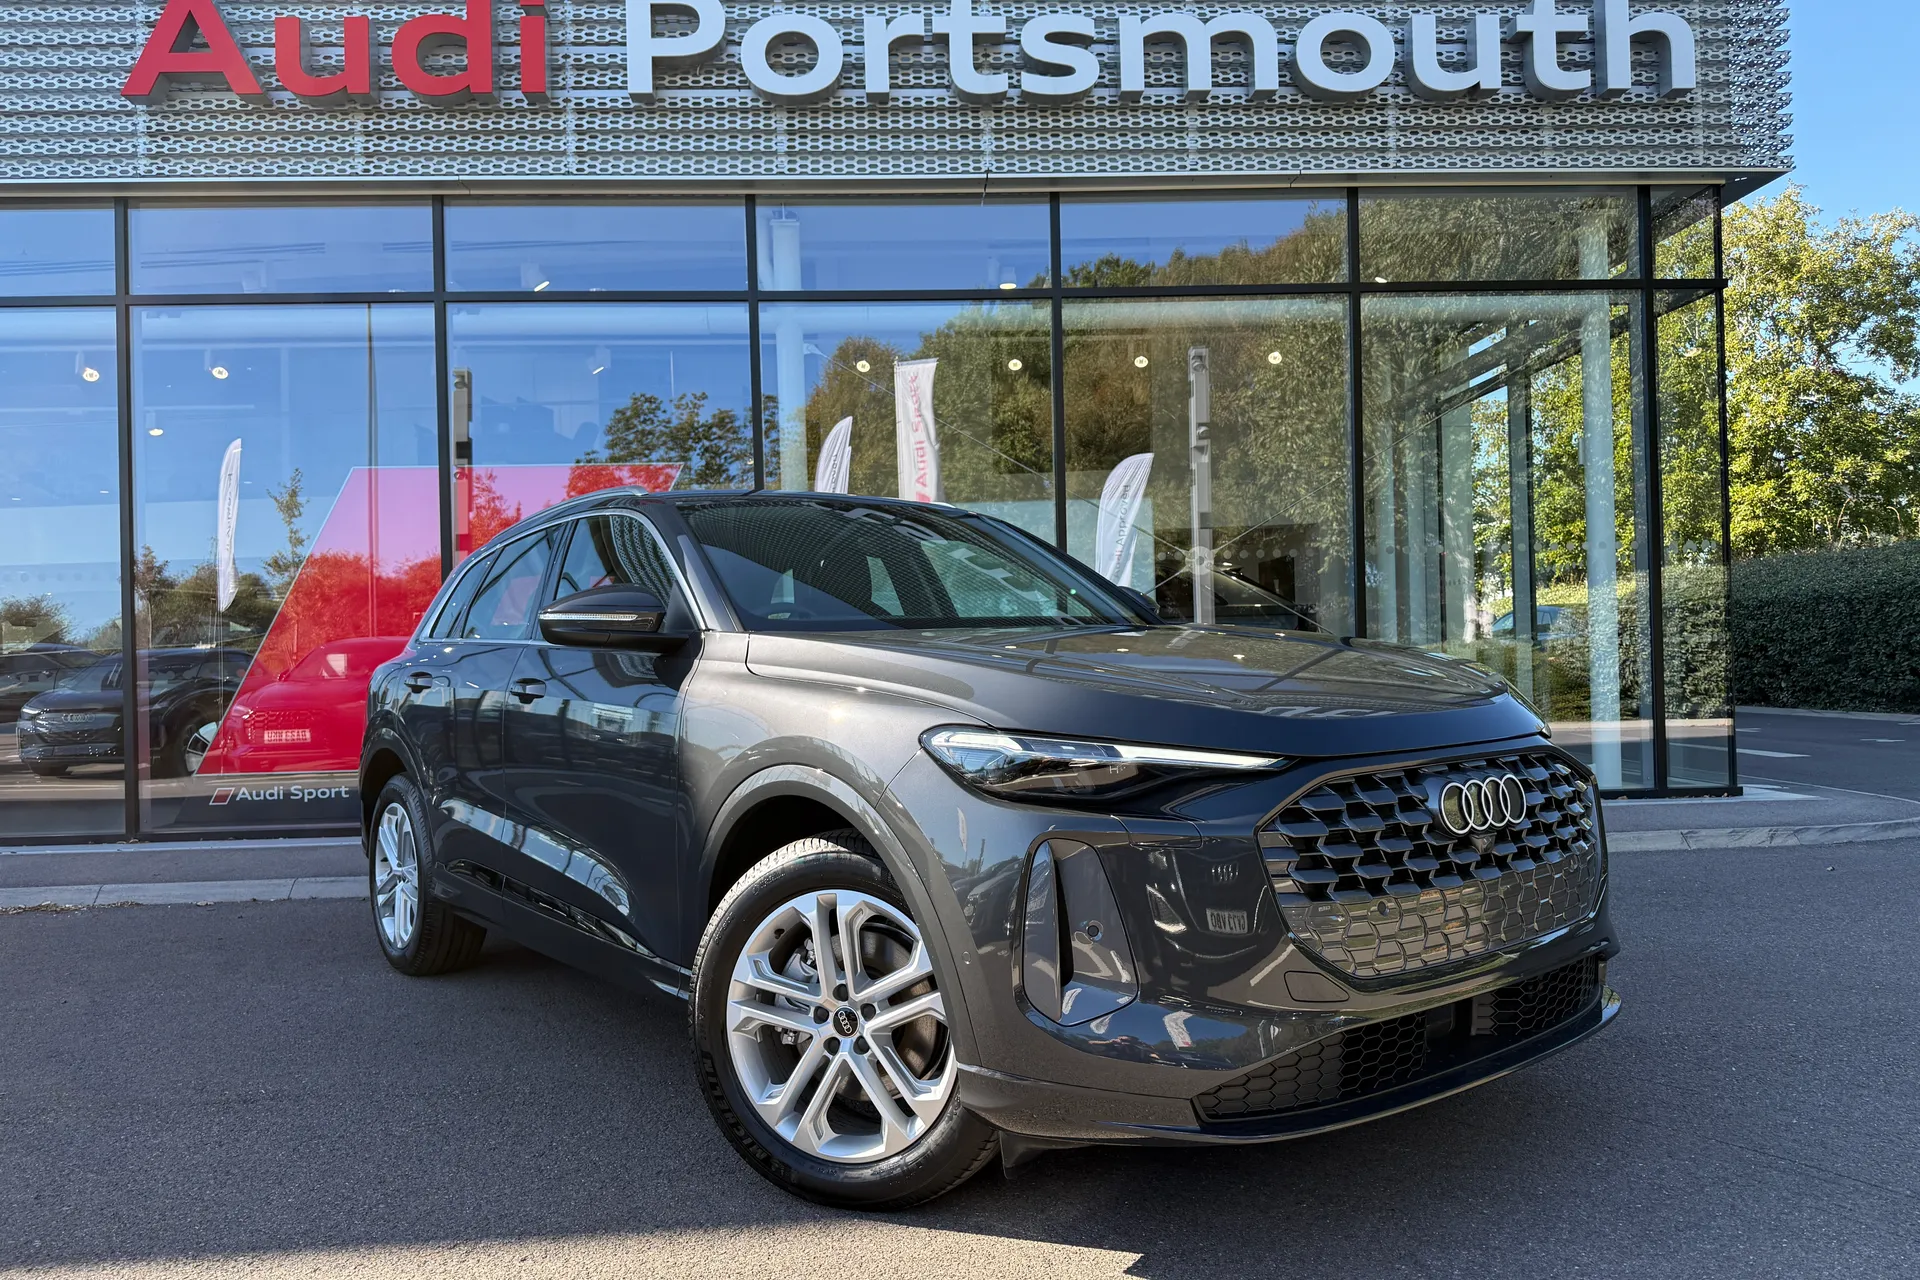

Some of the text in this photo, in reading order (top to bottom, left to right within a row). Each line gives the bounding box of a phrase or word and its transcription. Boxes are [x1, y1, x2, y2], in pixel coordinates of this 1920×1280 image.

[121, 0, 1697, 99] Audi Portsmouth
[909, 375, 929, 488] Audi Sport
[1115, 484, 1132, 546] Approved
[236, 785, 350, 802] Audi Sport
[702, 1055, 771, 1162] MICHELIN
